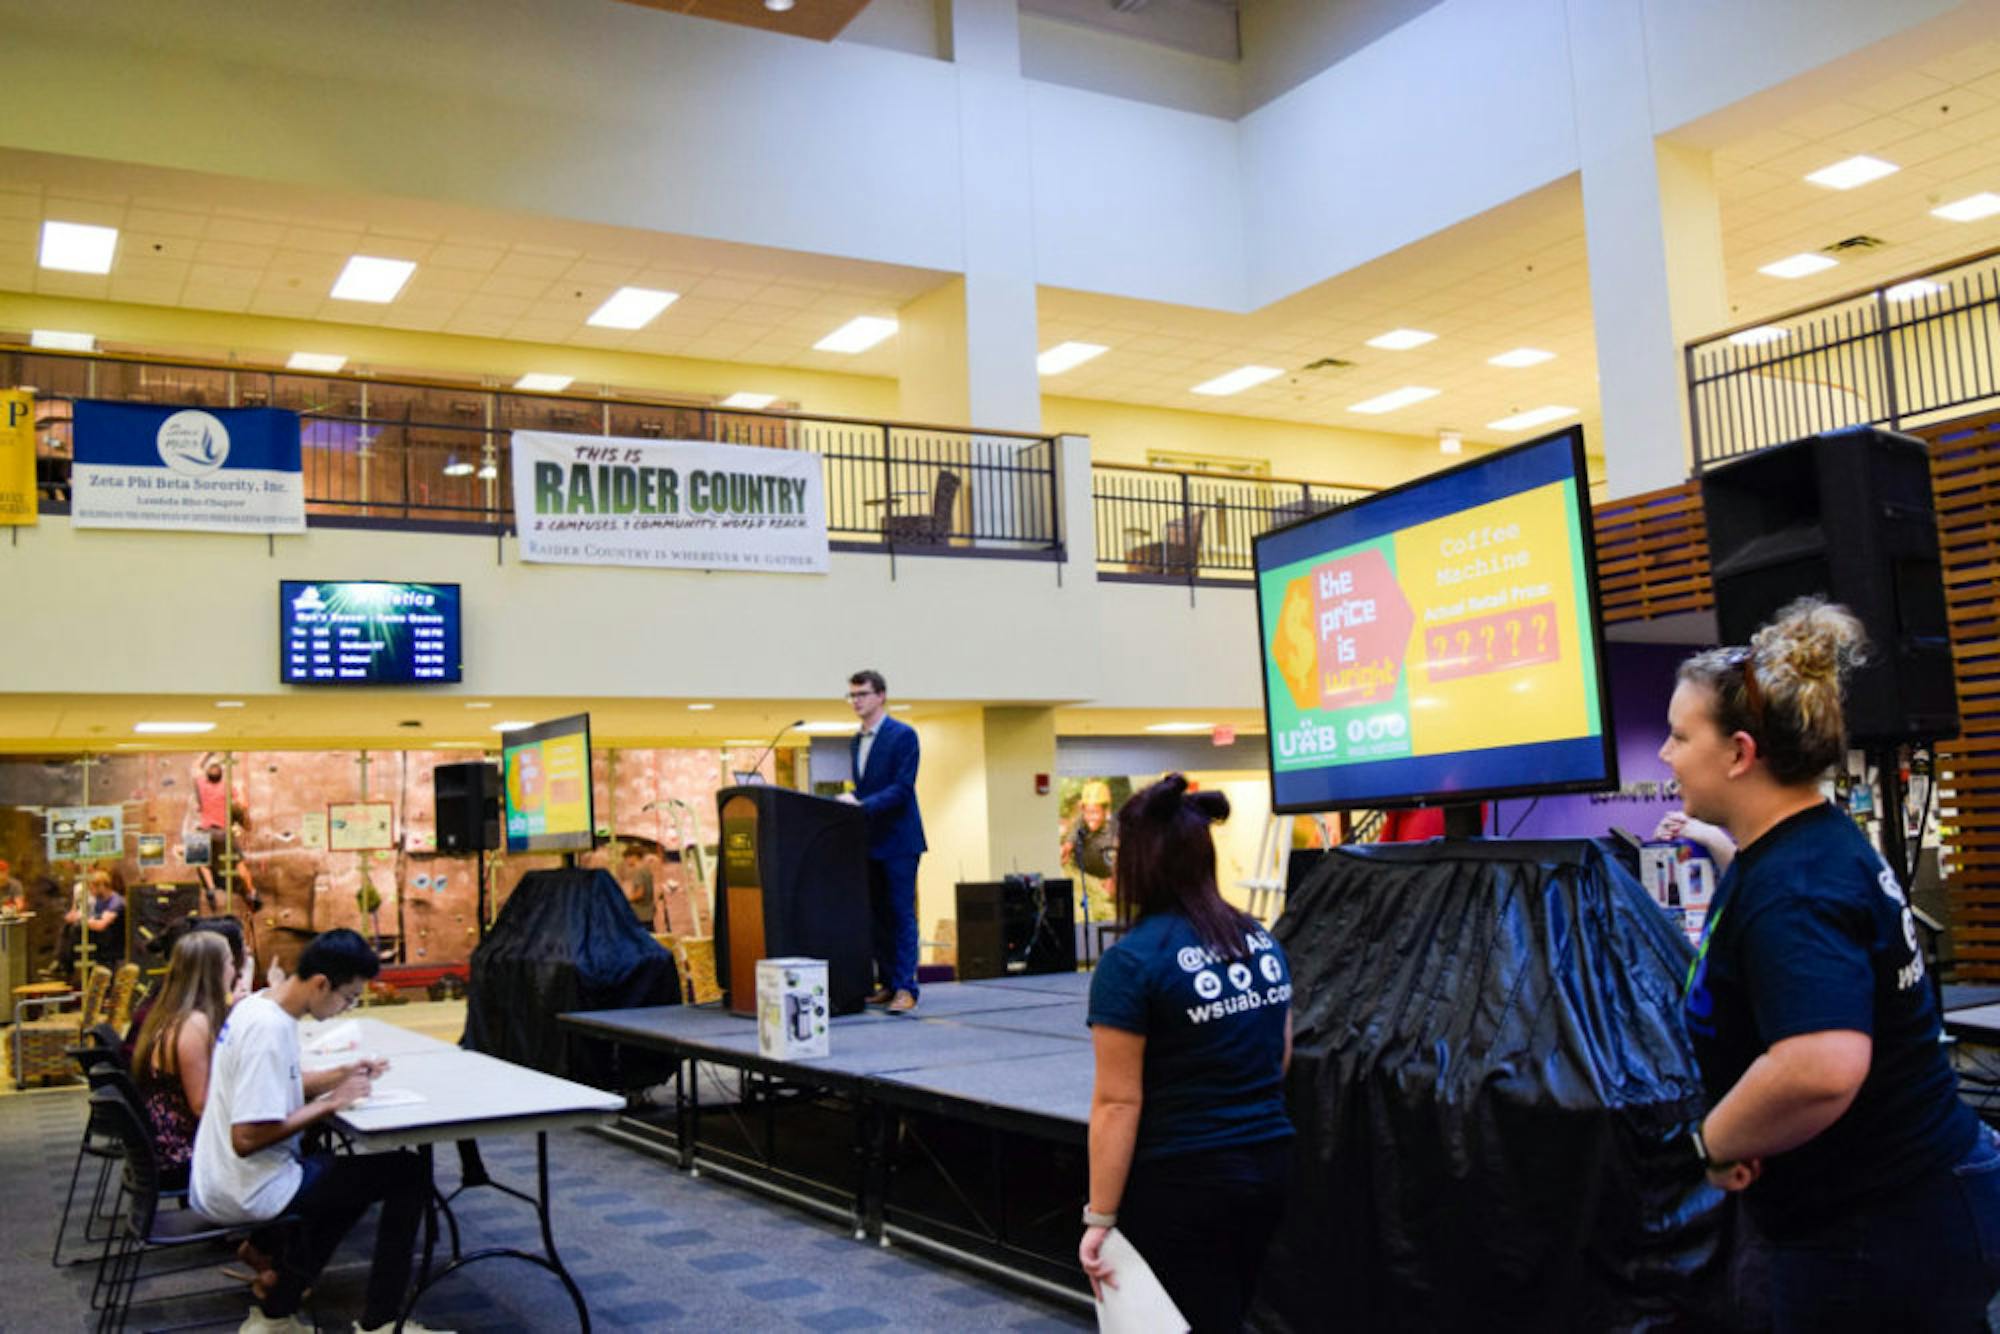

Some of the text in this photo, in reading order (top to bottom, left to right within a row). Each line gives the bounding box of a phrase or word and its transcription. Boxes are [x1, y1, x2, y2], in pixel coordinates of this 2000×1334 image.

[574, 445, 643, 464] THIS IS
[89, 474, 125, 488] Zeta
[127, 475, 153, 489] Phi
[156, 476, 190, 491] Beta
[194, 478, 260, 494] Sorority,
[533, 460, 808, 515] RAIDER COUNTRY
[1440, 523, 1521, 558] Coffee
[1319, 570, 1353, 600] the
[1436, 549, 1530, 586] Machine
[1320, 599, 1377, 641] price
[1336, 634, 1356, 663] is
[1325, 658, 1396, 698] wright
